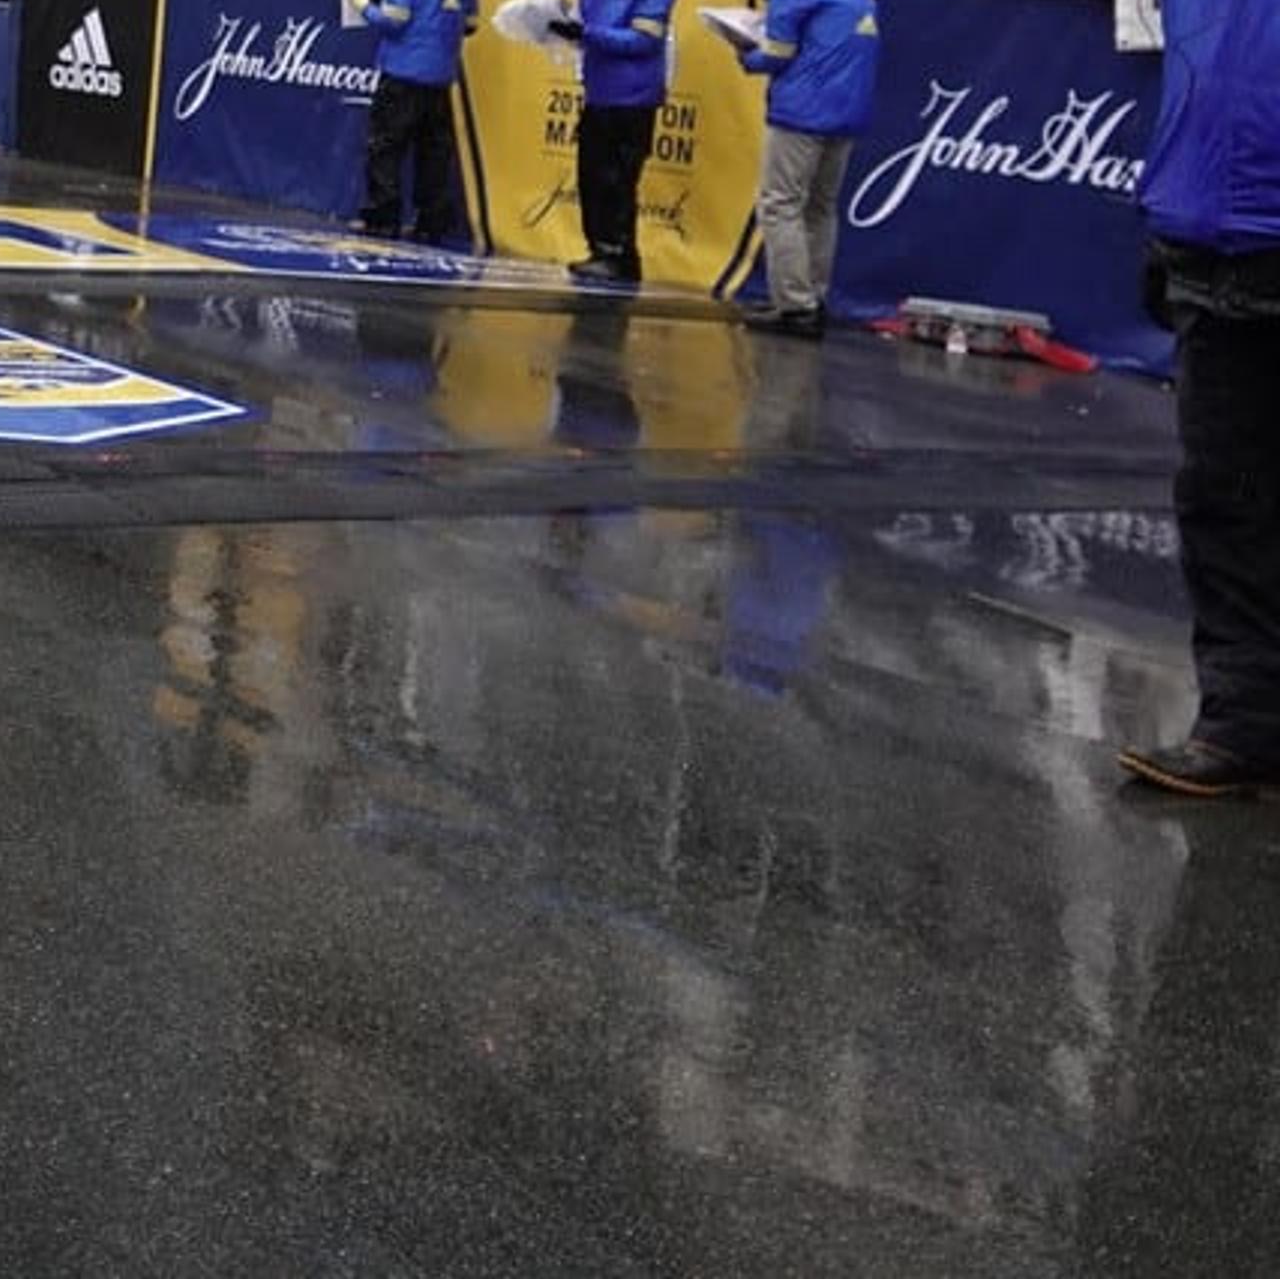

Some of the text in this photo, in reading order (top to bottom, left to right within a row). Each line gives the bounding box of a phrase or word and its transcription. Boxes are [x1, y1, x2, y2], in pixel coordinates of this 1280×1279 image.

[49, 62, 124, 98] adidas
[174, 11, 267, 121] John
[848, 79, 1024, 227] John
